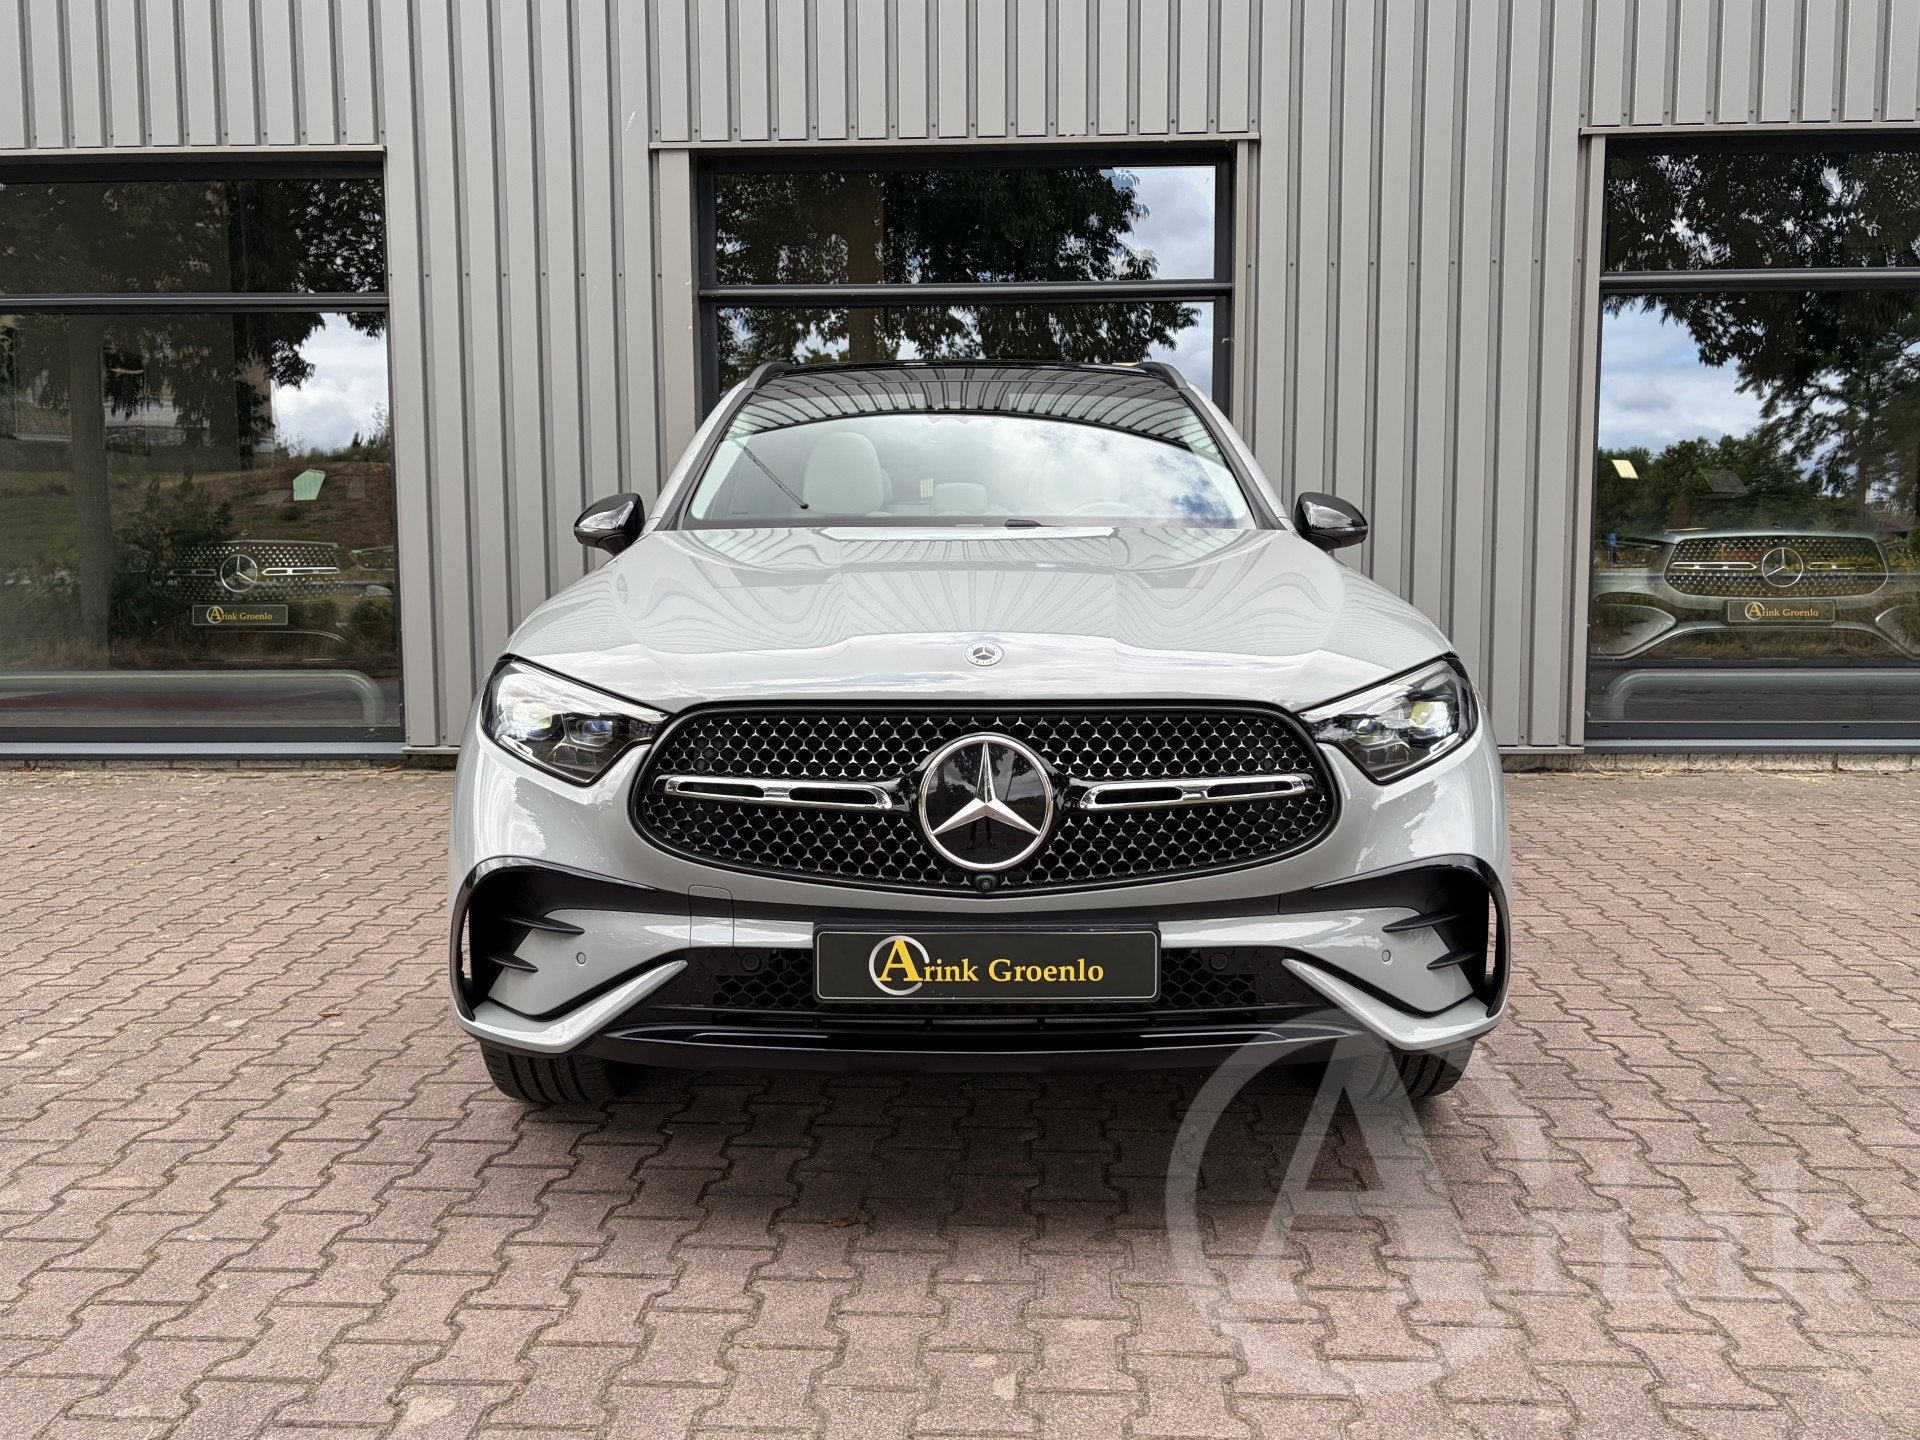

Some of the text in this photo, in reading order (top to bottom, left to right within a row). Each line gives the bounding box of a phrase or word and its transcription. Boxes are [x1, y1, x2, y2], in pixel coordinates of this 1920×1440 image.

[209, 607, 273, 620] Arink Groenlo
[1748, 602, 1819, 617] Arink Groenlo
[878, 938, 1104, 983] Arink Groenlo
